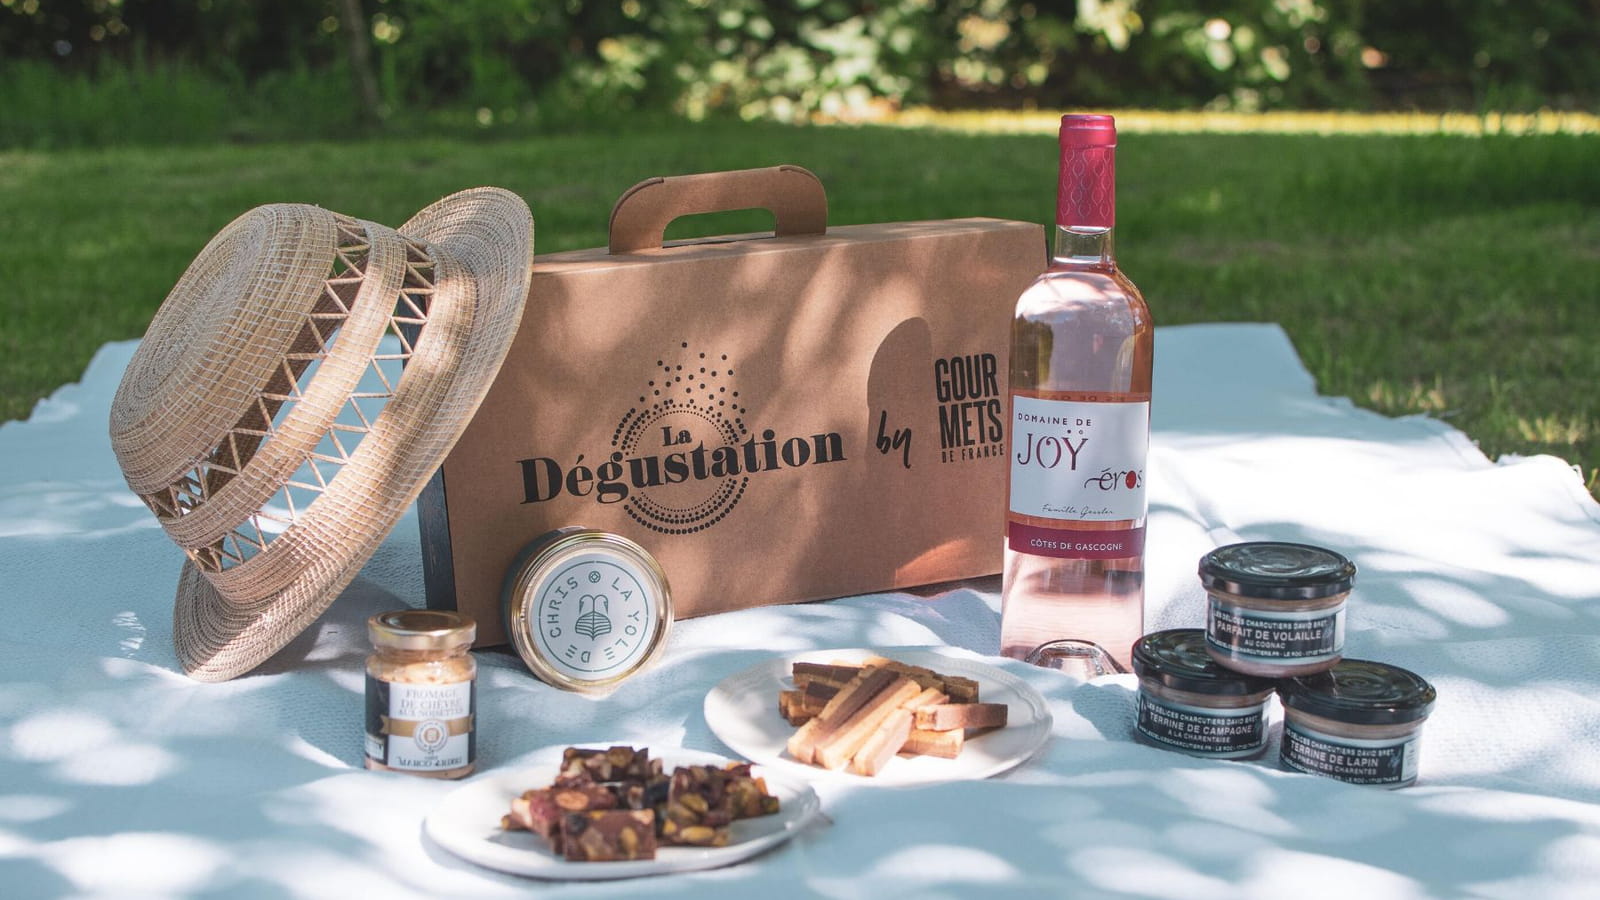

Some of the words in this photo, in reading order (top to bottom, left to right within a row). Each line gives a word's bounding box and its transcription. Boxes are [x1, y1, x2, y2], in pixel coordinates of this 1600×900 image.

[935, 353, 999, 403] GOUR
[939, 399, 1003, 449] METS
[1018, 412, 1068, 426] DOMAINE
[1076, 418, 1092, 426] DE
[661, 424, 692, 447] La
[876, 410, 912, 469] by
[942, 450, 954, 463] DE
[962, 444, 1004, 461] FRANCE
[515, 428, 847, 505] Dégustation
[1030, 538, 1057, 549] CÔTES
[1060, 542, 1072, 550] DE
[1075, 542, 1123, 551] GASCOGNE
[611, 577, 633, 602] LA
[547, 577, 578, 638] CHRIS
[604, 610, 640, 660] YOLE
[1216, 620, 1252, 637] PARFAIT
[1255, 631, 1270, 640] DE
[1272, 630, 1321, 641] VOLAILLE
[1246, 619, 1292, 630] CHARCUTIERS
[565, 644, 591, 663] DE
[1244, 639, 1254, 647] AU
[1255, 641, 1286, 650] COGNAC
[401, 699, 415, 708] DE
[406, 688, 457, 699] FROMAGE
[1150, 711, 1184, 731] TERRINE
[1187, 725, 1200, 734] DE
[1202, 725, 1252, 736] CAMPAGNE
[1180, 714, 1225, 726] CHARCUTIERS
[1183, 733, 1231, 743] CHARENTAISE
[1311, 740, 1357, 756] CHARCUTIERS
[1291, 740, 1325, 761] TERRINE
[1329, 754, 1343, 765] DE
[1346, 757, 1379, 767] LAPIN
[1298, 754, 1318, 767] PINEAU
[1319, 761, 1333, 771] DES
[1334, 765, 1377, 775] CHARENTES
